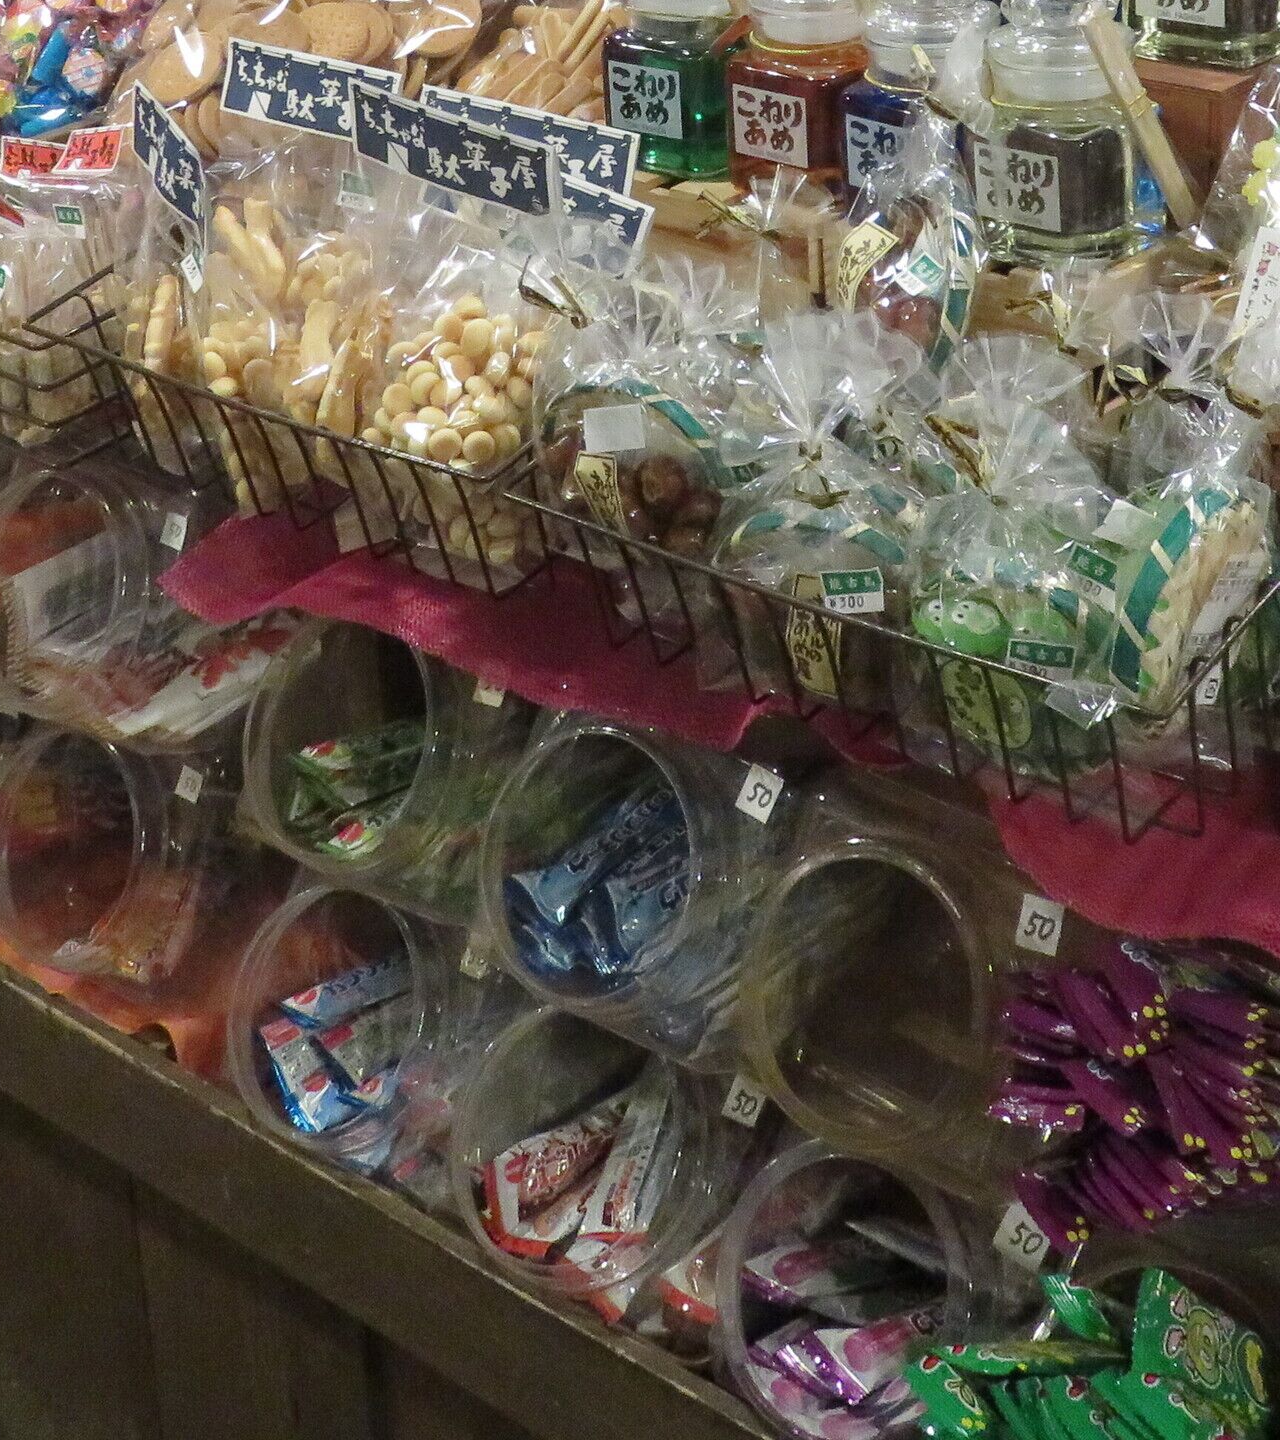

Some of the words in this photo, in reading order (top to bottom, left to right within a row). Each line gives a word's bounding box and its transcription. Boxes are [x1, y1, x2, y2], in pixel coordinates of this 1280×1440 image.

[612, 64, 677, 101] こねり
[619, 94, 670, 127] あめ
[736, 90, 804, 128] こねり
[362, 98, 539, 198] ちっちゃな駄菓子屋
[743, 118, 795, 153] あめ
[978, 147, 1055, 188] こねり
[746, 781, 774, 809] 50
[1023, 912, 1055, 942] 50
[731, 1089, 758, 1115] 50
[1009, 1222, 1044, 1254] 50
